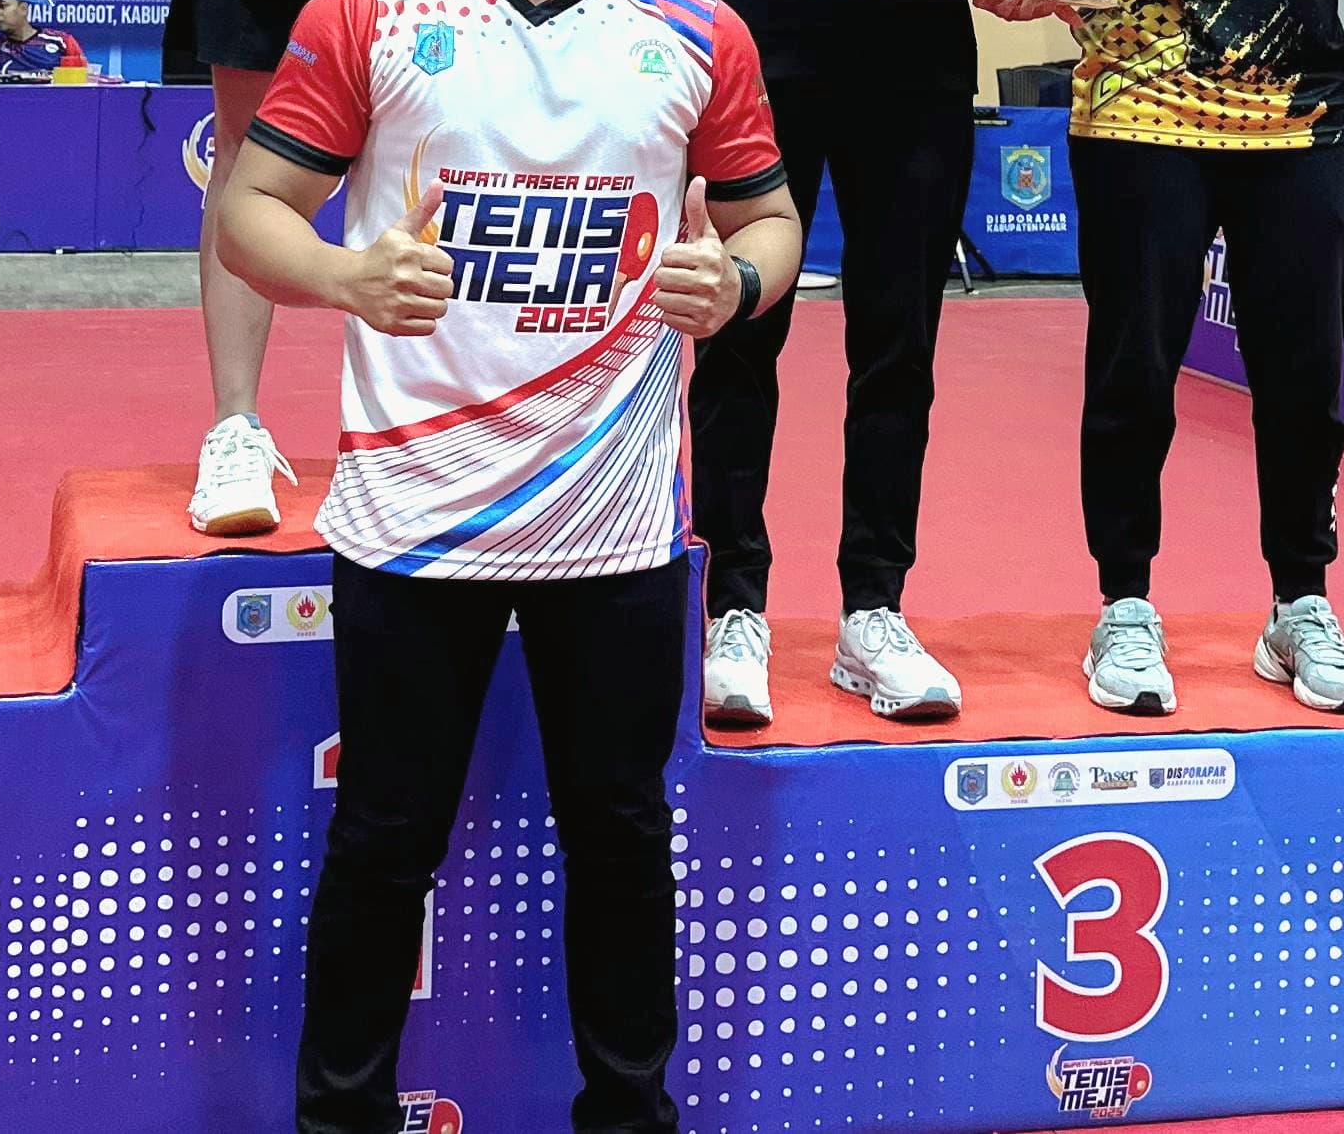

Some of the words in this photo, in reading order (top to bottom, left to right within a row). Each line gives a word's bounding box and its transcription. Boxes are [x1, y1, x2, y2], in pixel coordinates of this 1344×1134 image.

[56, 4, 117, 26] GROGOT,
[439, 167, 506, 188] BUPATI
[513, 173, 580, 190] PASER
[585, 175, 635, 191] OPEN
[439, 190, 632, 250] TENIS
[986, 213, 1067, 224] DISPORAPAR
[437, 245, 620, 305] MEJA
[514, 306, 608, 333] 2025
[1088, 766, 1138, 783] Paser
[1167, 766, 1227, 779] DISPORAPAR
[1040, 836, 1164, 1037] 3
[1062, 1066, 1131, 1089] TENIS
[1060, 1087, 1128, 1111] MEJA
[1091, 1108, 1123, 1118] 2025
